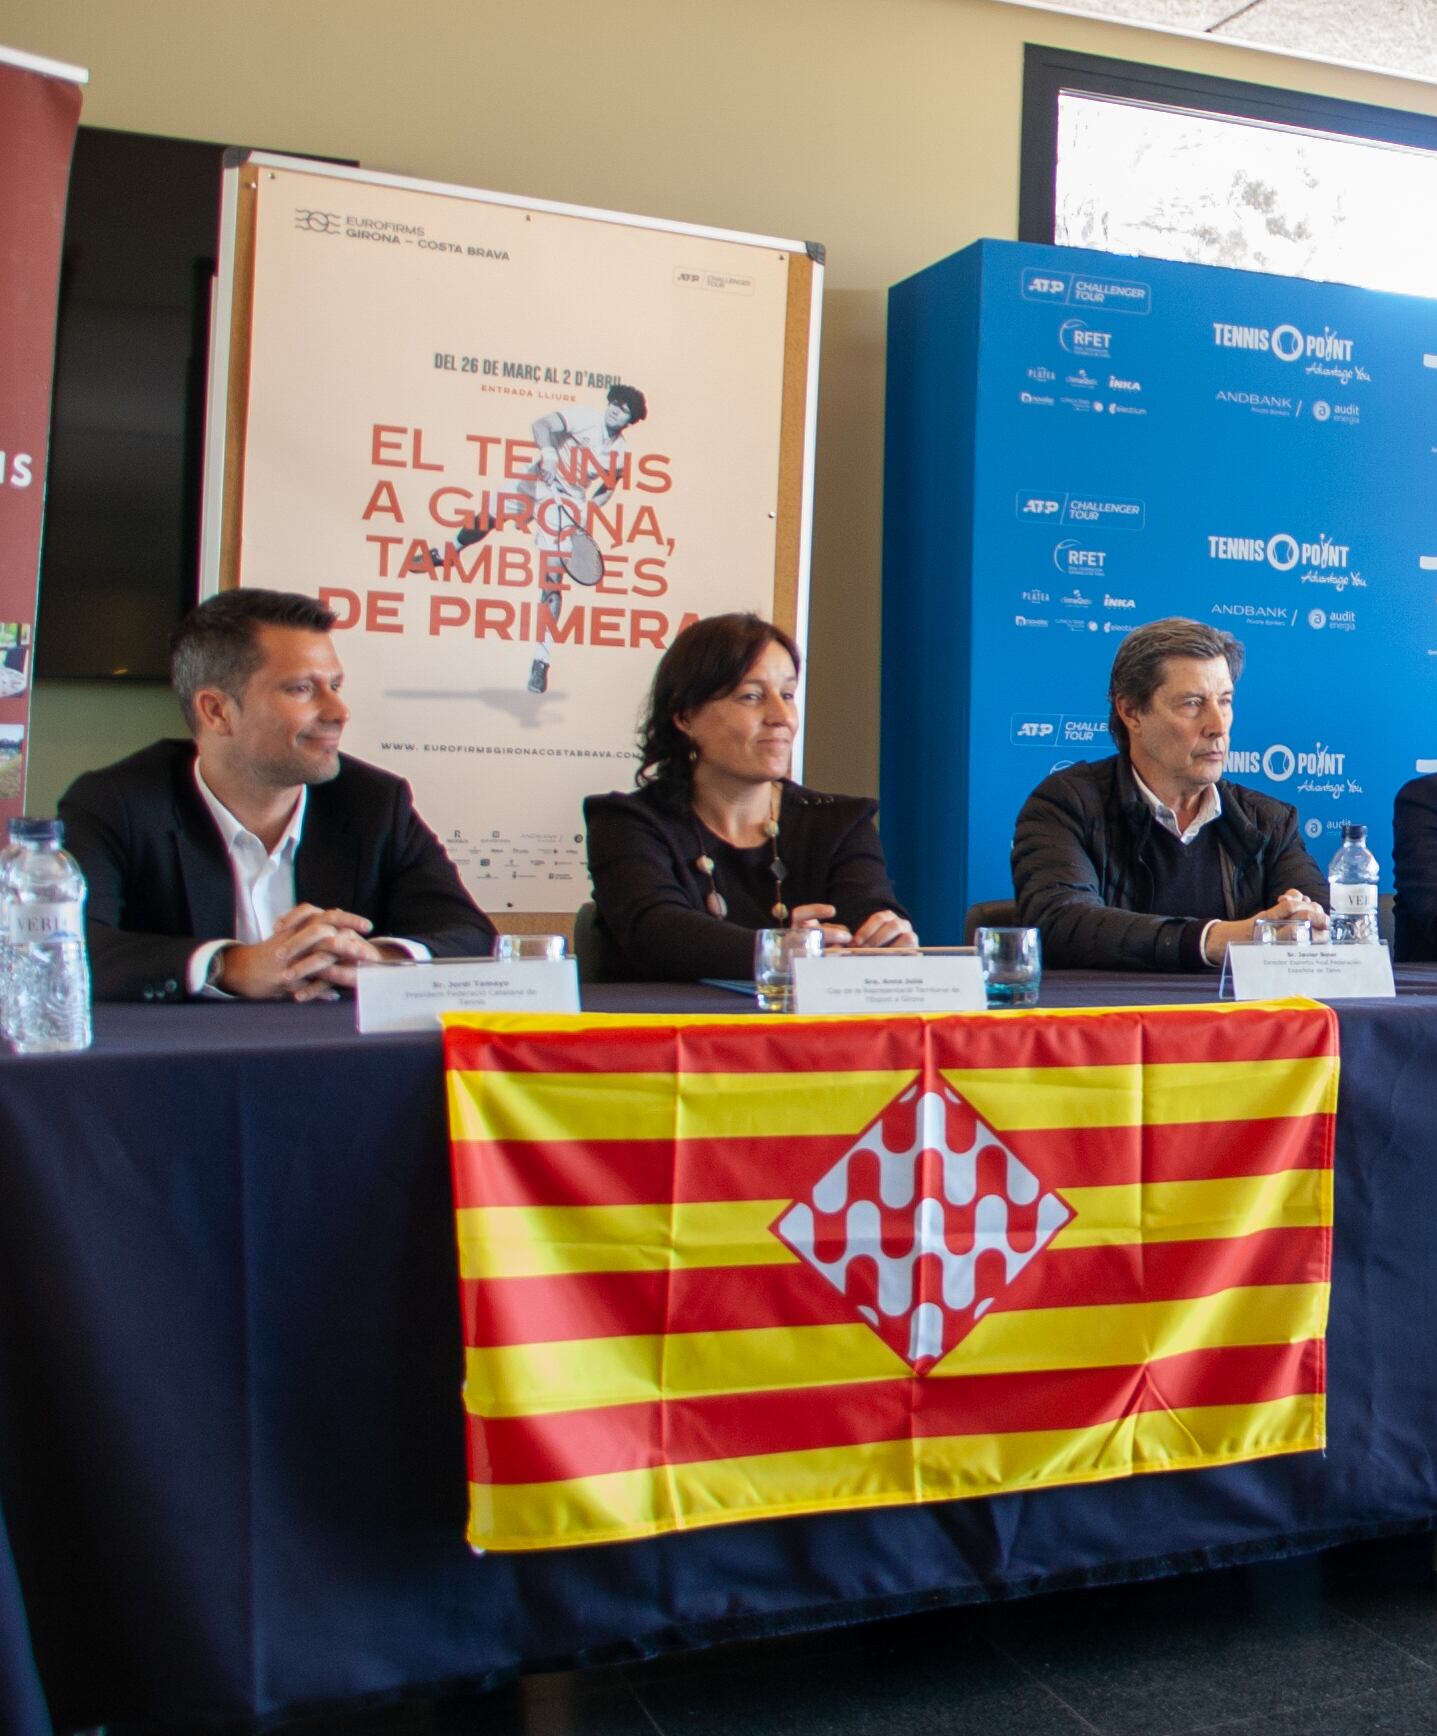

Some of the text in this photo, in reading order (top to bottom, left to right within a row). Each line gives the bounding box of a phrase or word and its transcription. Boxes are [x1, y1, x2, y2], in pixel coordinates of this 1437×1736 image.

[346, 216, 425, 236] EUROFIRMS
[346, 229, 400, 244] GIRONA
[418, 239, 463, 254] COSTA
[467, 246, 510, 261] BRAVA
[1028, 278, 1065, 294] ATP
[1076, 281, 1145, 299] CHALLENGER
[1075, 291, 1105, 303] TOUR
[1074, 330, 1112, 348] RFET
[1213, 323, 1269, 350] TENNIS
[434, 353, 457, 371] DEL
[461, 356, 478, 373] 26
[482, 359, 499, 376] DE
[503, 361, 540, 384] MARÇ
[544, 366, 560, 384] AL
[563, 369, 571, 385] 2
[1355, 365, 1371, 382] You
[481, 384, 533, 397] ENTRADA
[1215, 391, 1292, 408] ANDBANK
[1334, 404, 1359, 416] audit
[371, 424, 673, 494] EL TENNIS
[1023, 499, 1059, 514] ATP
[1070, 500, 1140, 515] CHALLENGER
[362, 480, 675, 556] A GIRONA,
[1070, 510, 1099, 521] TOUR
[1208, 536, 1265, 562] TENNIS
[1068, 550, 1106, 567] RFET
[1301, 570, 1367, 592] Advantage You
[318, 586, 404, 634] DE
[1211, 603, 1288, 618] ANDBANK
[1329, 611, 1356, 622] audit
[1017, 722, 1054, 737] ATP
[1064, 731, 1094, 741] TOUR
[1297, 778, 1364, 799] Advantage You
